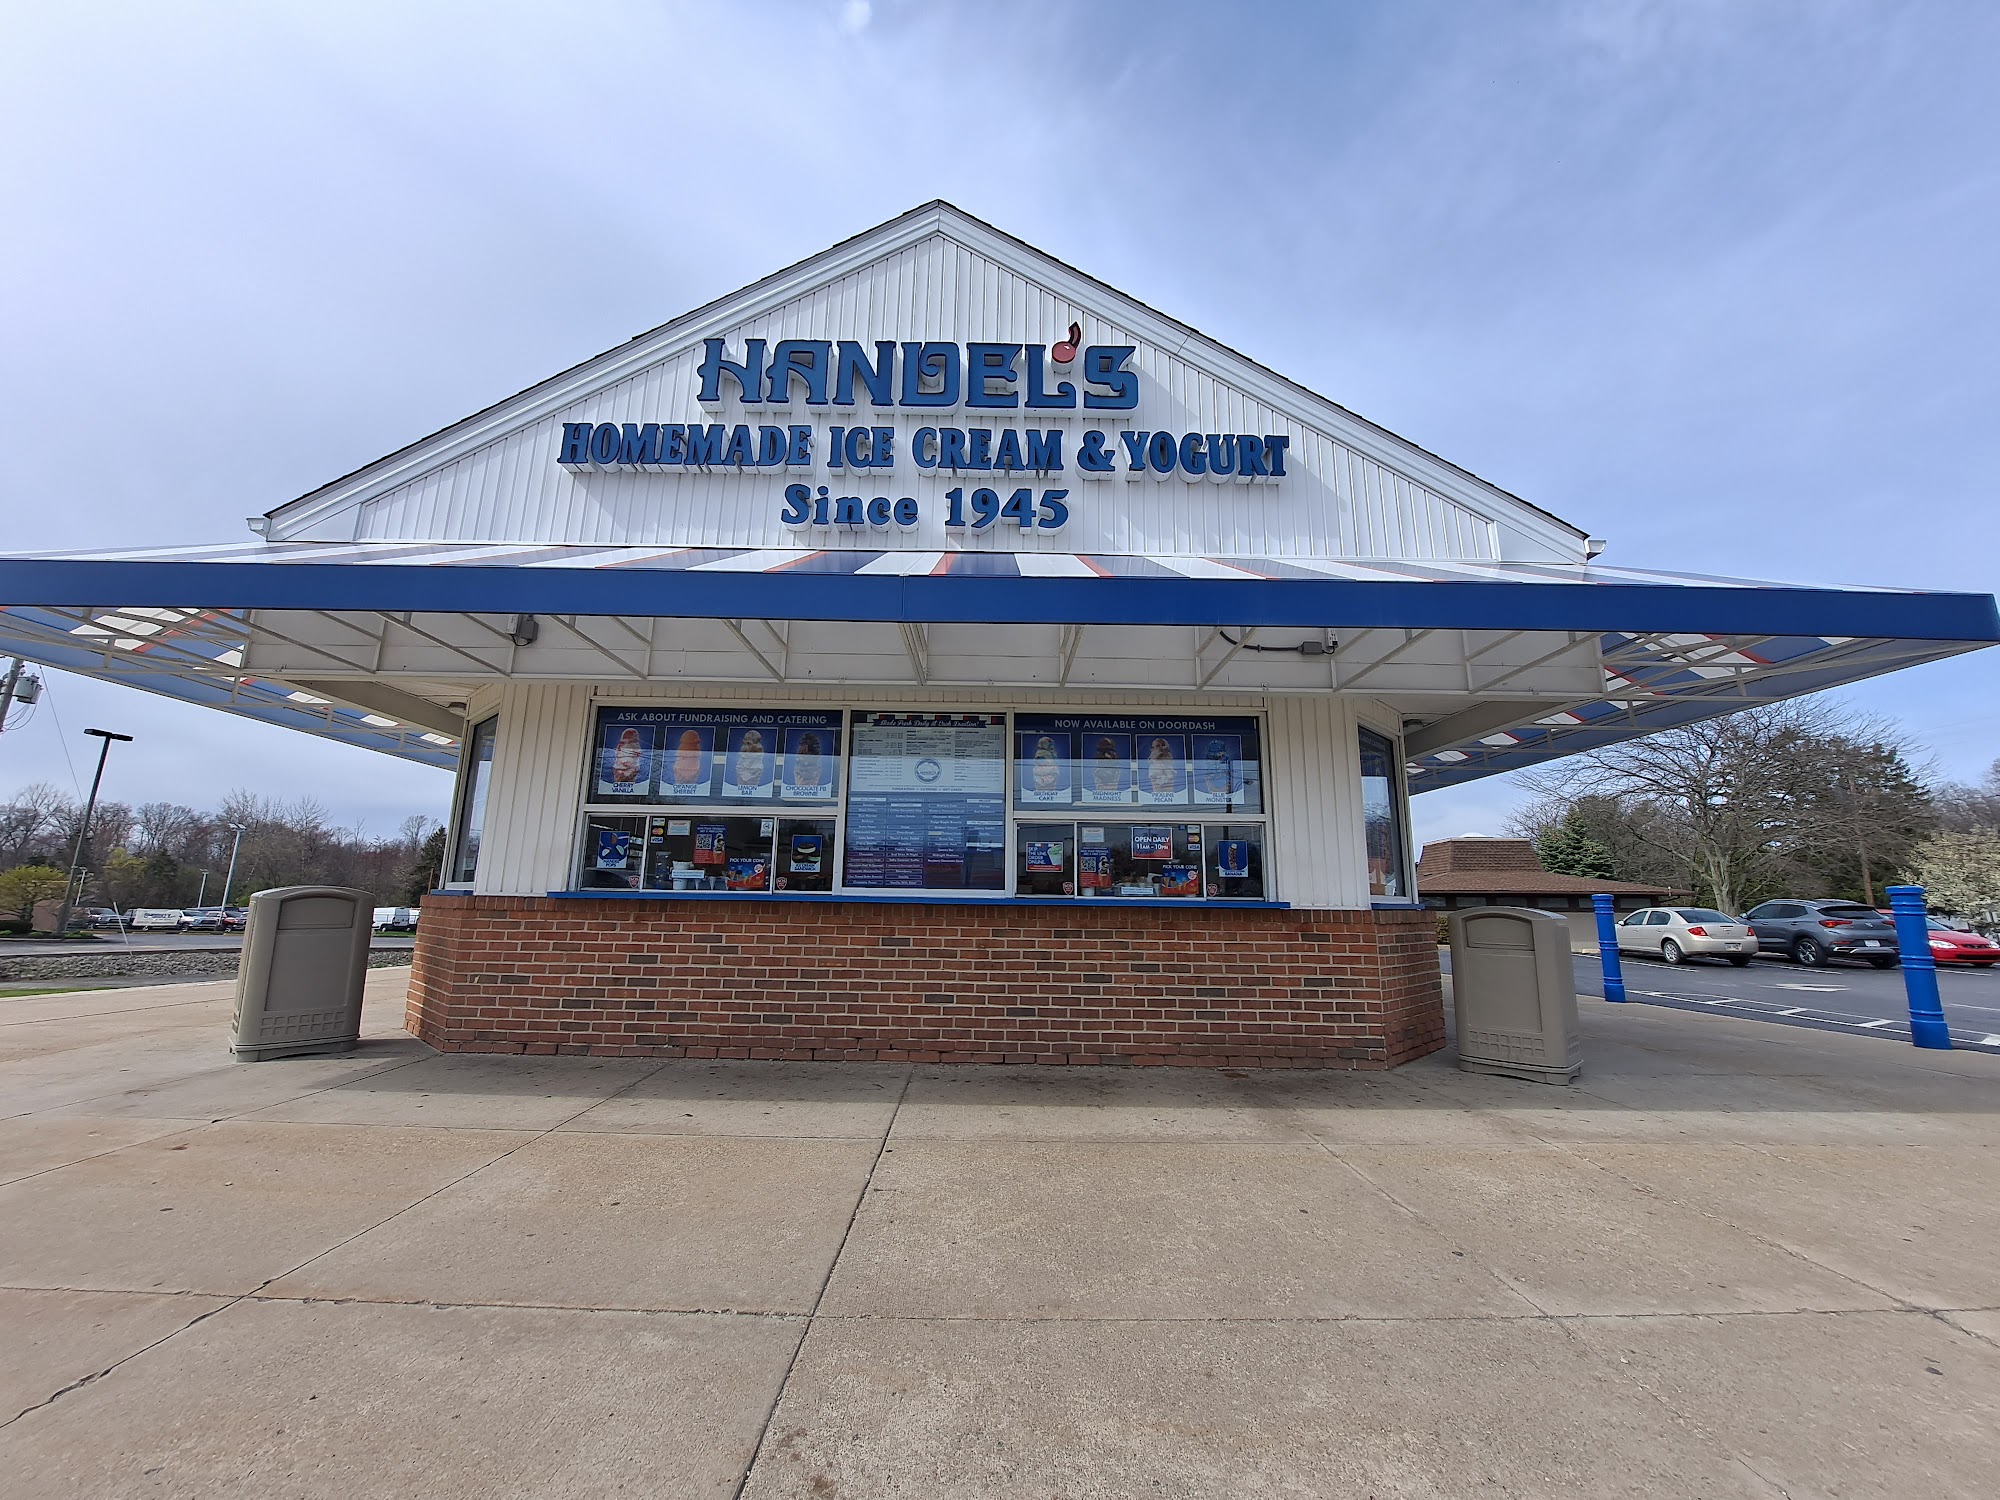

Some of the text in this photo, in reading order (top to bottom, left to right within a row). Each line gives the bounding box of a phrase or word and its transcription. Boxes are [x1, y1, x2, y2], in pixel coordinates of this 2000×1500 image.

[697, 324, 1139, 410] HANDEL'S
[557, 422, 1289, 477] HOMEMADE ICE CREAM & YOGURT
[781, 485, 1069, 530] Since 1945
[617, 712, 827, 724] ASK ABOUT FUNDRAISING AND CATERING
[1054, 719, 1216, 730] NOW AVAILABLE ON DOORDASH
